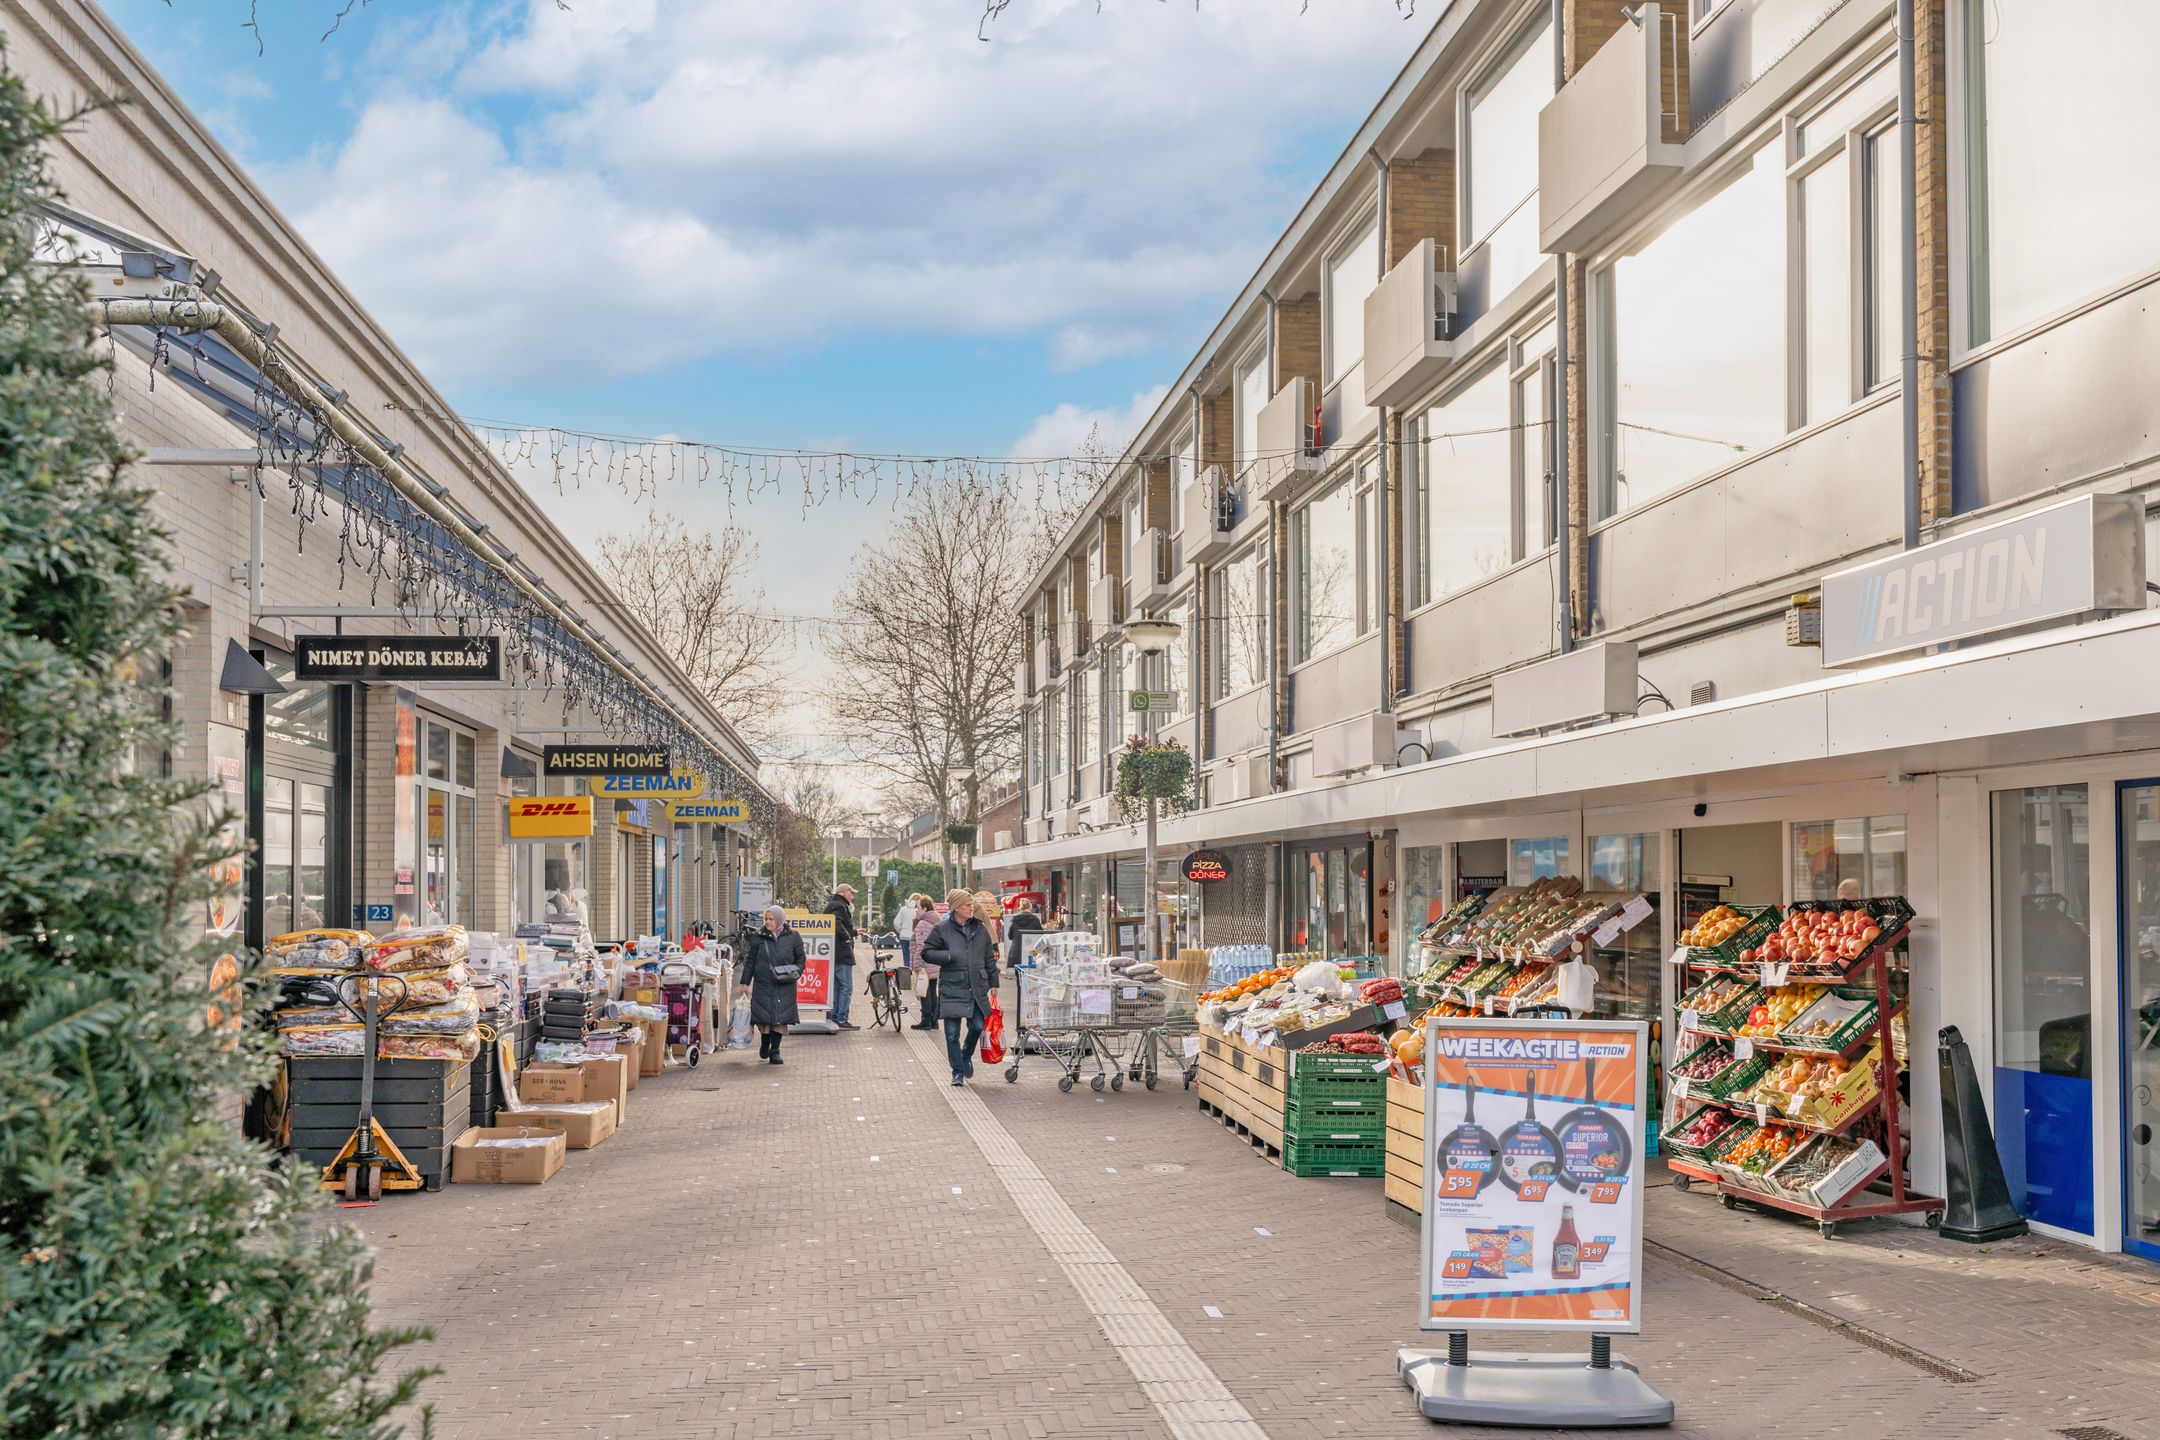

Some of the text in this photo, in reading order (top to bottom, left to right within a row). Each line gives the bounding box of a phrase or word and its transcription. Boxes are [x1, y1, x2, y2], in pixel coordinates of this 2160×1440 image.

[1875, 526, 2048, 642] ACTION
[308, 647, 488, 666] NIMET DÖNER KEBAB
[549, 753, 664, 768] AHSEN HOME
[604, 775, 692, 791] ZEEMAN
[520, 803, 580, 816] DHL
[674, 805, 740, 817] ZEEMAN
[371, 906, 389, 919] 23
[803, 937, 830, 955] ale
[799, 974, 822, 987] 0%
[1442, 1037, 1625, 1058] WEEKACTIE ACTION
[1572, 1133, 1608, 1142] SUPERIOR
